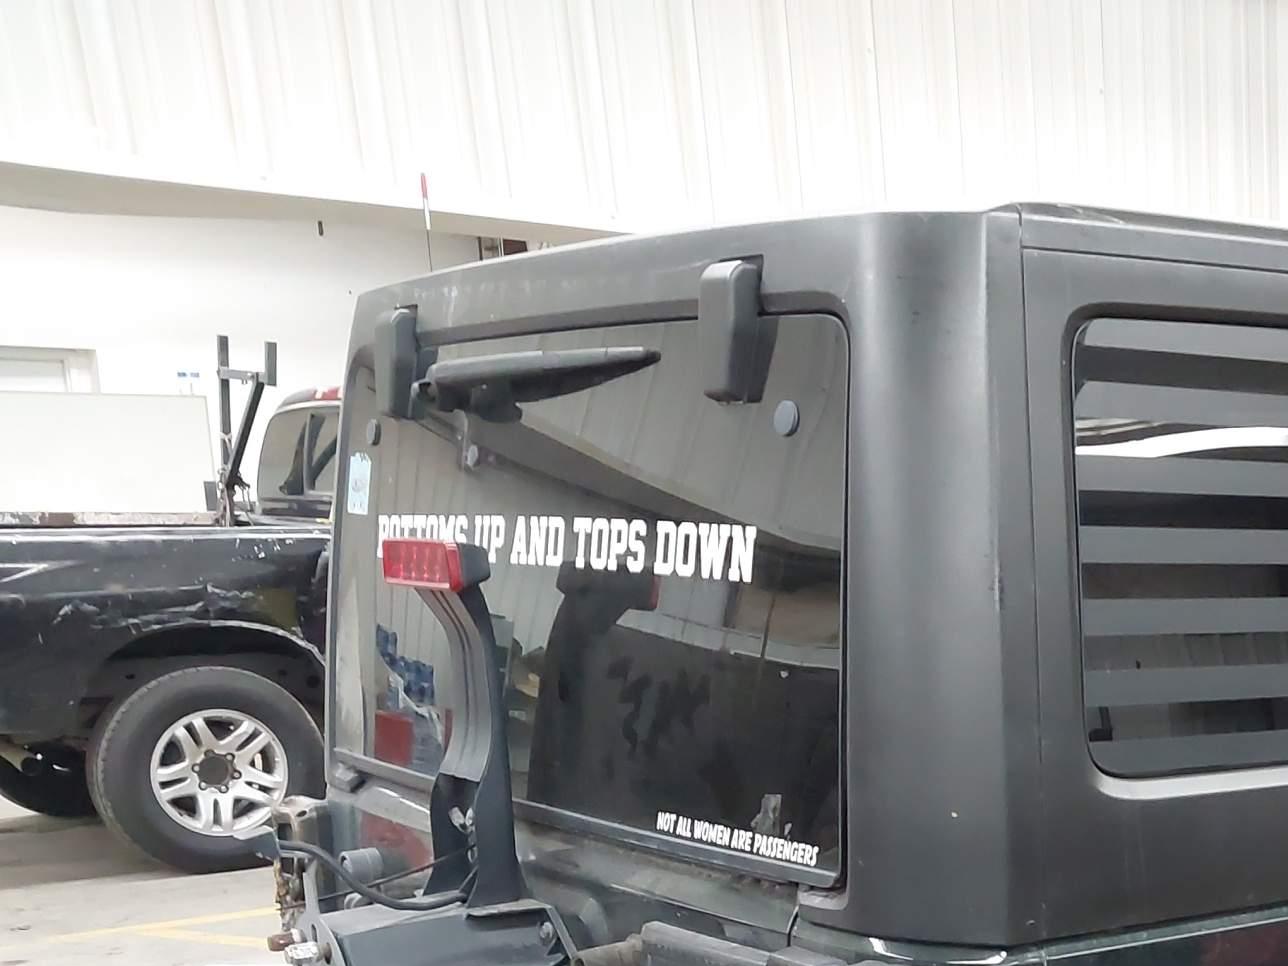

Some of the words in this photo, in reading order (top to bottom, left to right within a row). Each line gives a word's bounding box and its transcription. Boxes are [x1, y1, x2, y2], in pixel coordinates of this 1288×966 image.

[474, 514, 506, 564] UP
[509, 516, 566, 567] AND
[572, 517, 648, 574] TOPS
[653, 520, 758, 583] DOWN
[656, 811, 677, 832] NOT
[675, 815, 693, 838] ALL
[693, 820, 731, 847] WOMEN
[730, 828, 753, 852] ARE
[753, 833, 819, 866] PASSENGERS
